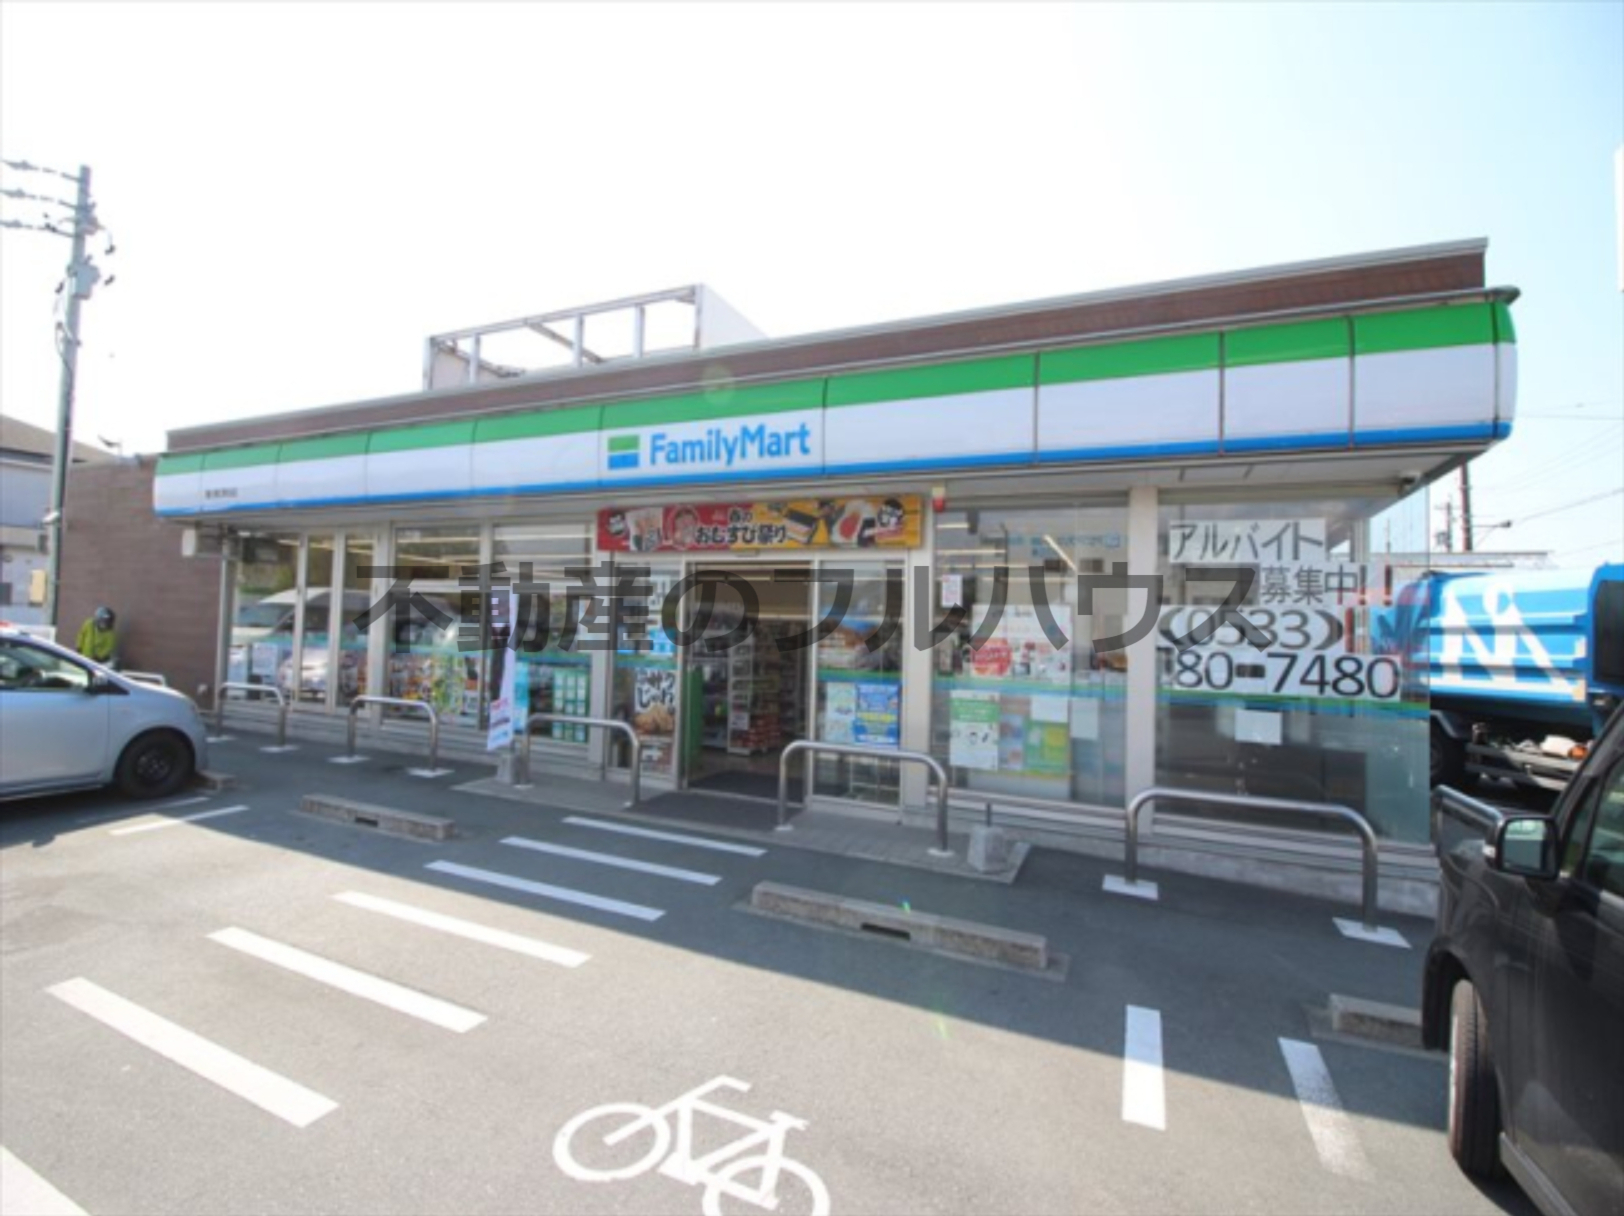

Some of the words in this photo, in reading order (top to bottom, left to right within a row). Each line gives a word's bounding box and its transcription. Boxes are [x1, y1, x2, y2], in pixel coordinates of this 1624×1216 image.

[650, 422, 811, 466] FamilyMart
[1170, 520, 1324, 561] アルバイト
